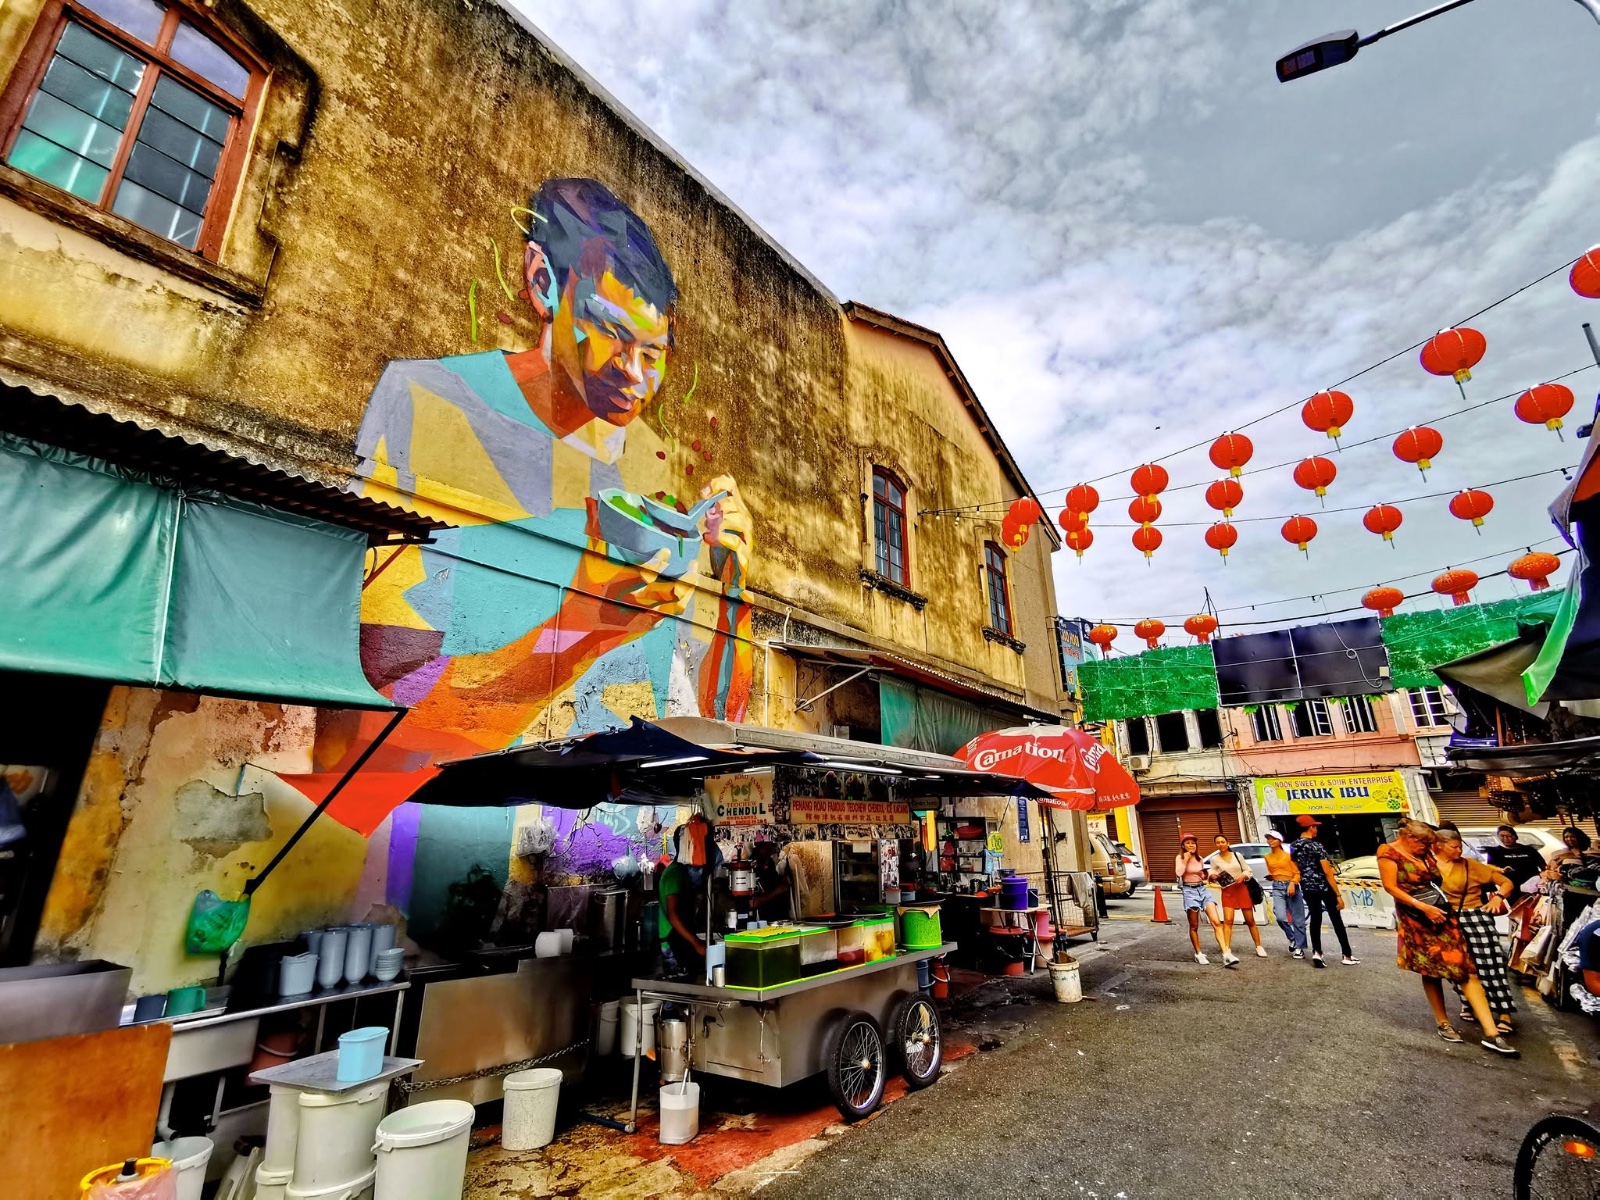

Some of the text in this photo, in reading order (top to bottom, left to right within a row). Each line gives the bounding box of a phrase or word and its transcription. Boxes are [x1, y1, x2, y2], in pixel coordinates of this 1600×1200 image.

[974, 741, 1067, 771] Carnation
[1328, 778, 1346, 786] SOUR
[1349, 776, 1393, 784] ENTERPRISE
[1286, 787, 1369, 801] JERUK IBU
[717, 803, 766, 816] CHENDUL
[792, 800, 812, 811] PENANG
[813, 801, 826, 811] ROAD
[827, 801, 845, 812] FAMOUS
[1350, 888, 1374, 907] MB
